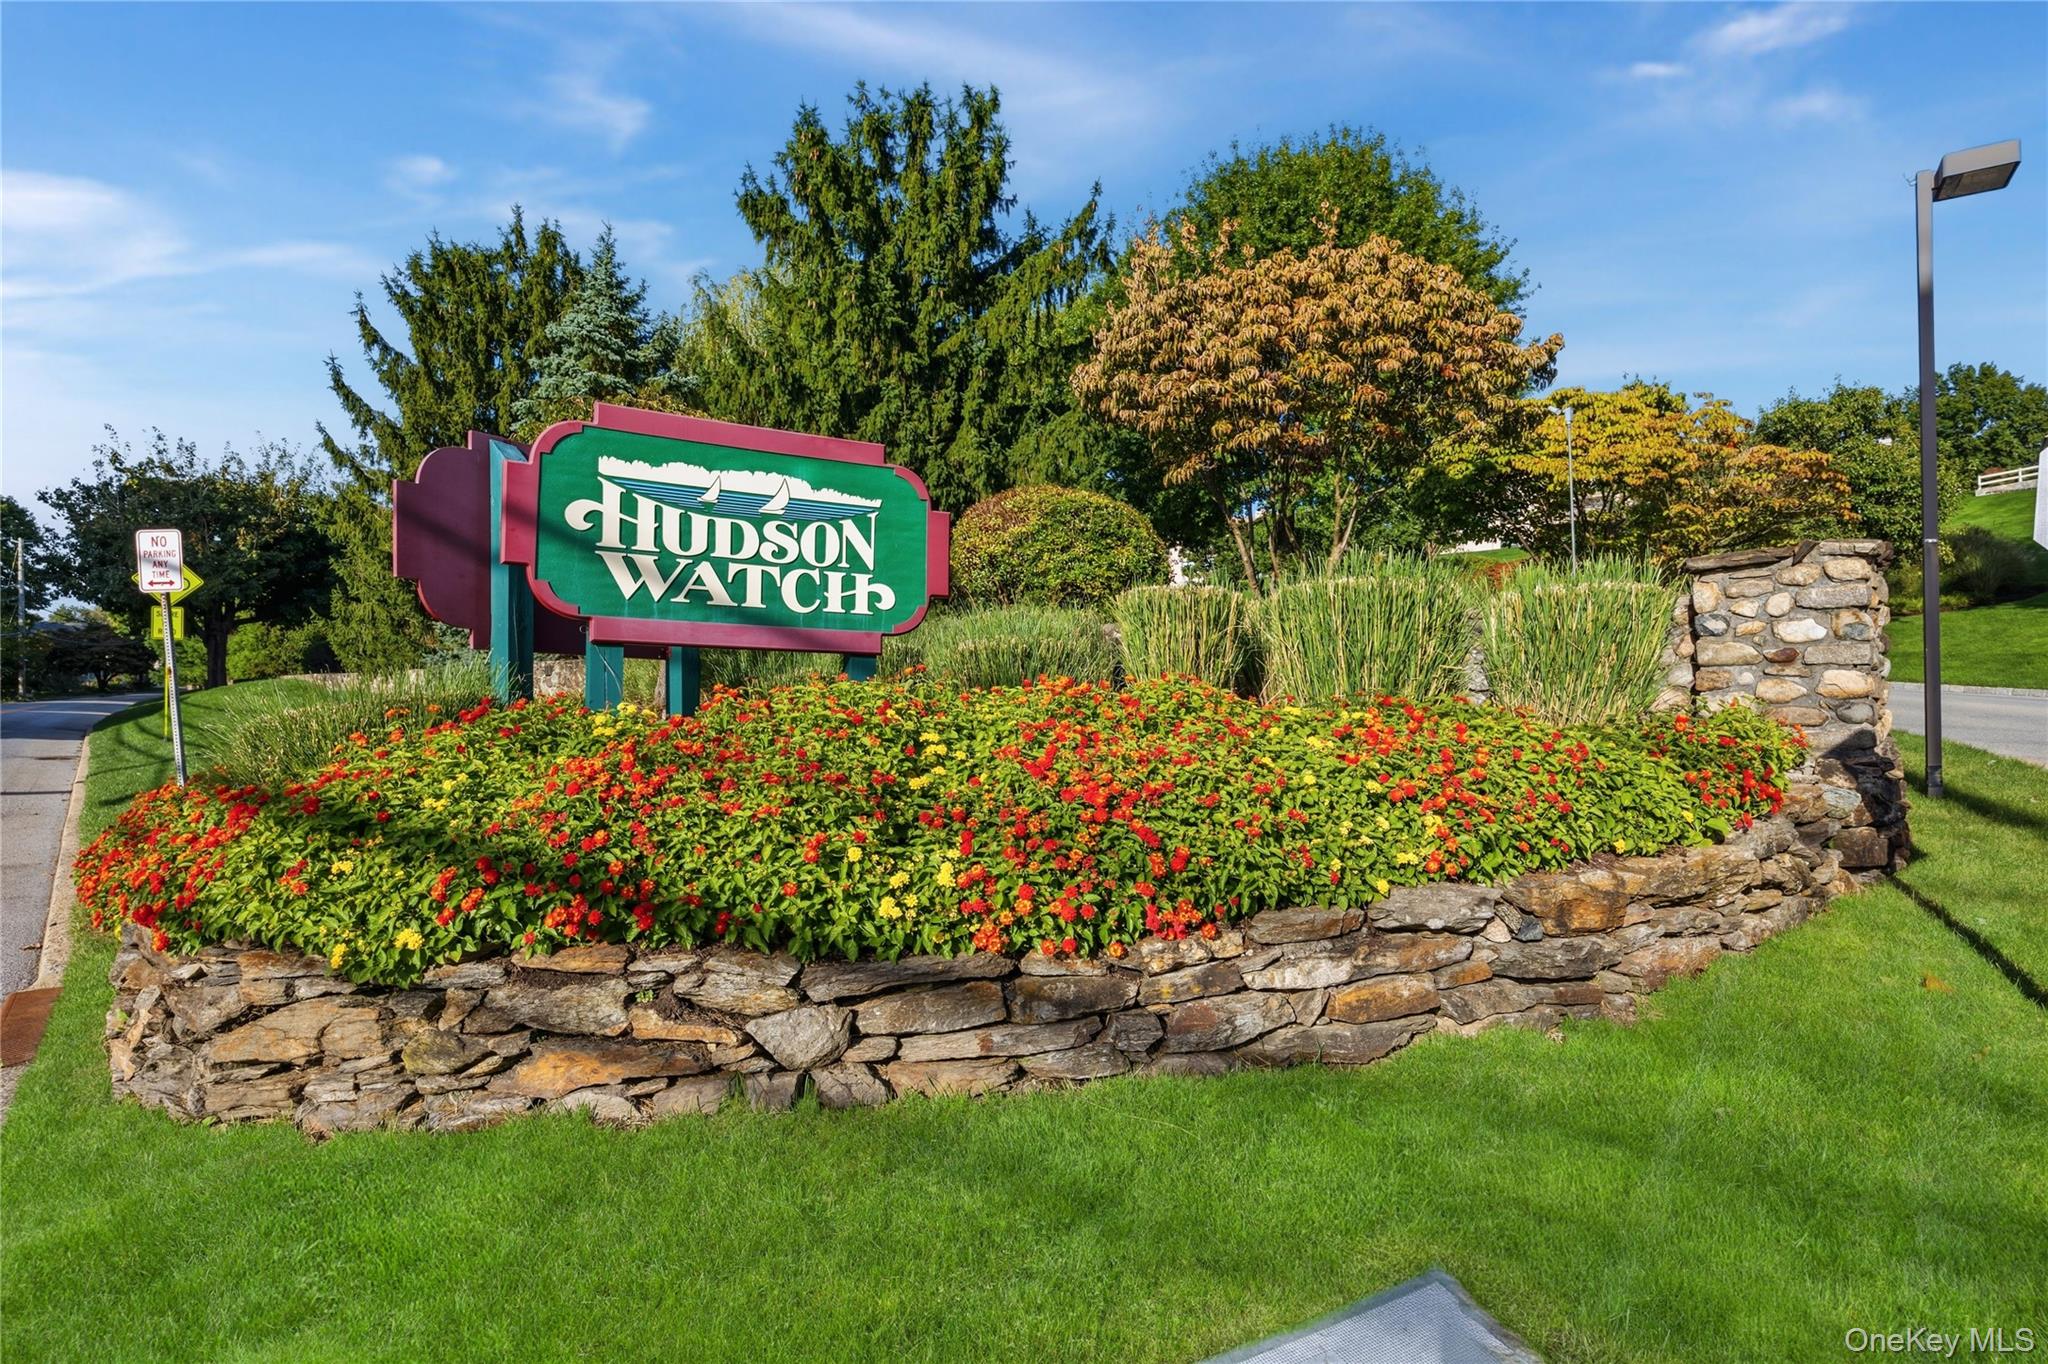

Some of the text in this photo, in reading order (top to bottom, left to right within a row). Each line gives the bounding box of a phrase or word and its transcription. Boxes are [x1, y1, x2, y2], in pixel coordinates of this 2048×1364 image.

[564, 475, 880, 572] HUDSON
[151, 536, 167, 548] NO
[143, 550, 177, 559] PARKING
[152, 560, 169, 569] ANY
[152, 570, 171, 579] TIME
[594, 549, 897, 616] WATCH
